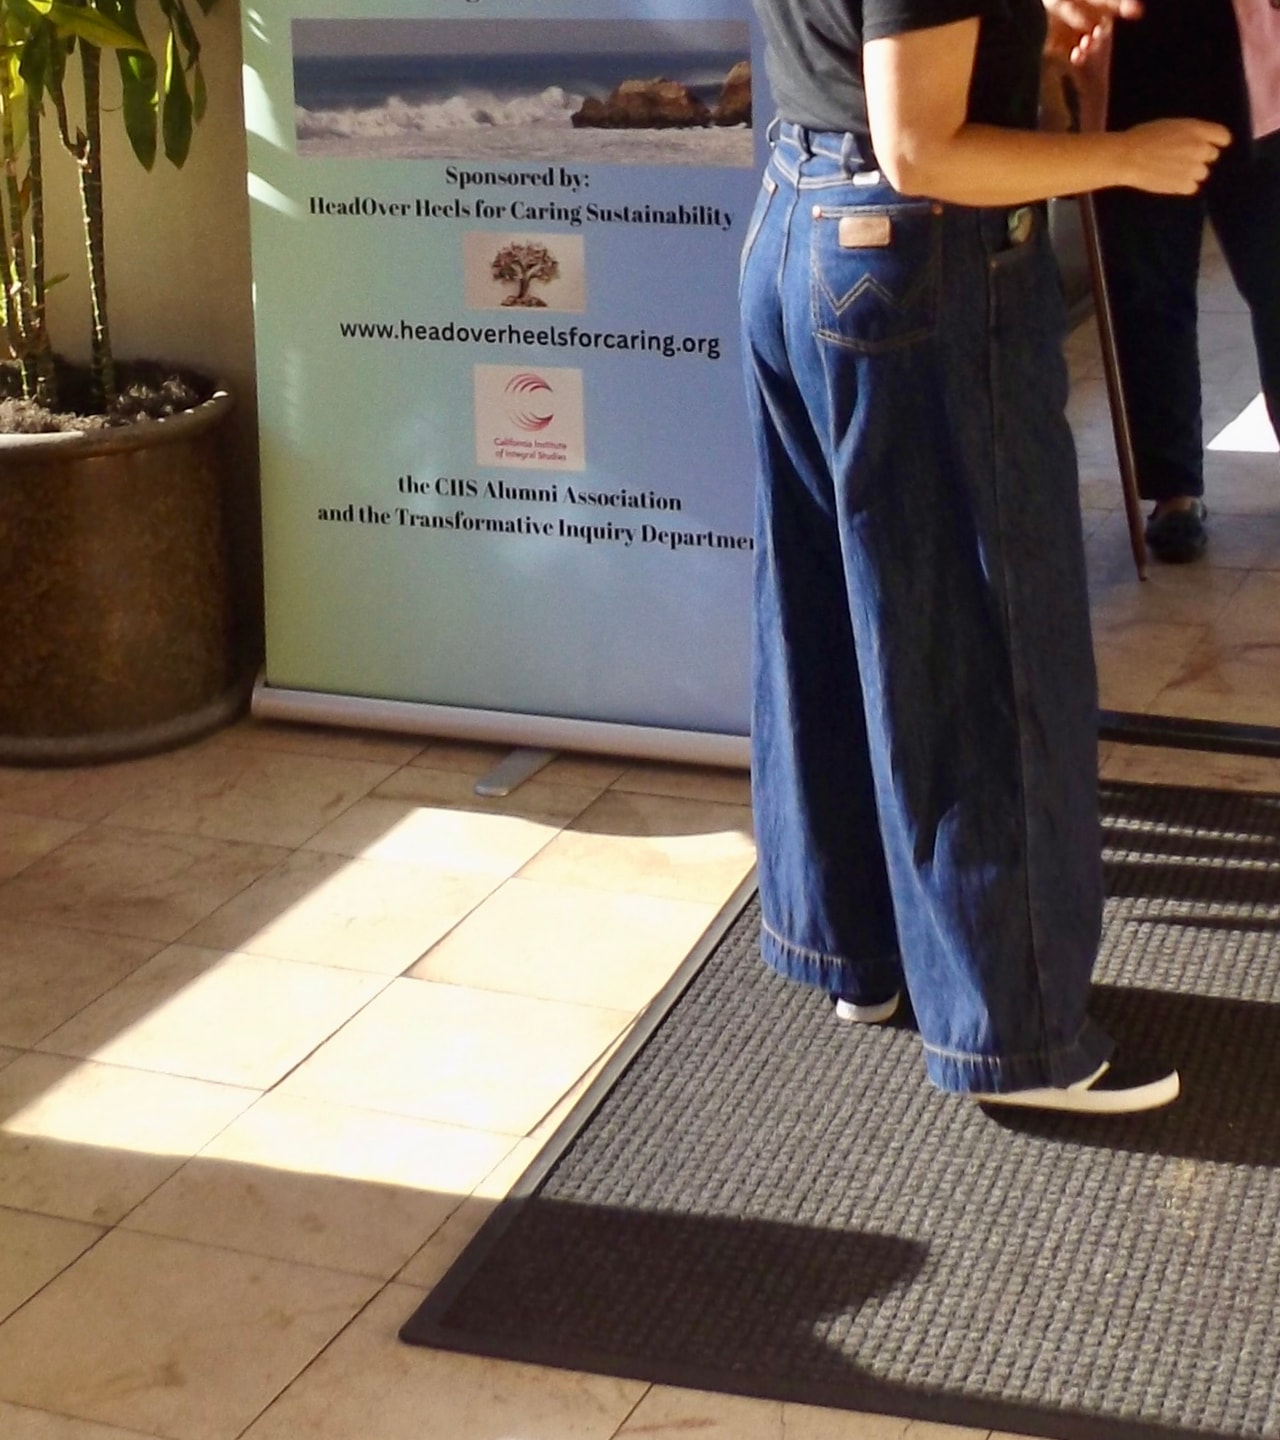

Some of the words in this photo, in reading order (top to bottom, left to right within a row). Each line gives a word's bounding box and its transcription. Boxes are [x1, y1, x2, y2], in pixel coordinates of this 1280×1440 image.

[445, 166, 555, 190] Sponsored
[559, 167, 589, 193] by:
[415, 198, 471, 218] Heels
[475, 199, 506, 219] for
[510, 201, 583, 226] Caring
[586, 203, 734, 231] Sustainability
[339, 319, 721, 360] www.headoverheelsforcaring.org
[398, 474, 430, 494] the
[435, 478, 478, 497] CIIS
[482, 480, 558, 503] Alumni
[562, 486, 682, 511] Association
[318, 504, 354, 522] and
[358, 505, 391, 525] the
[395, 508, 554, 536] Transformative
[559, 518, 637, 547] Inquiry
[641, 524, 754, 551] Departme
